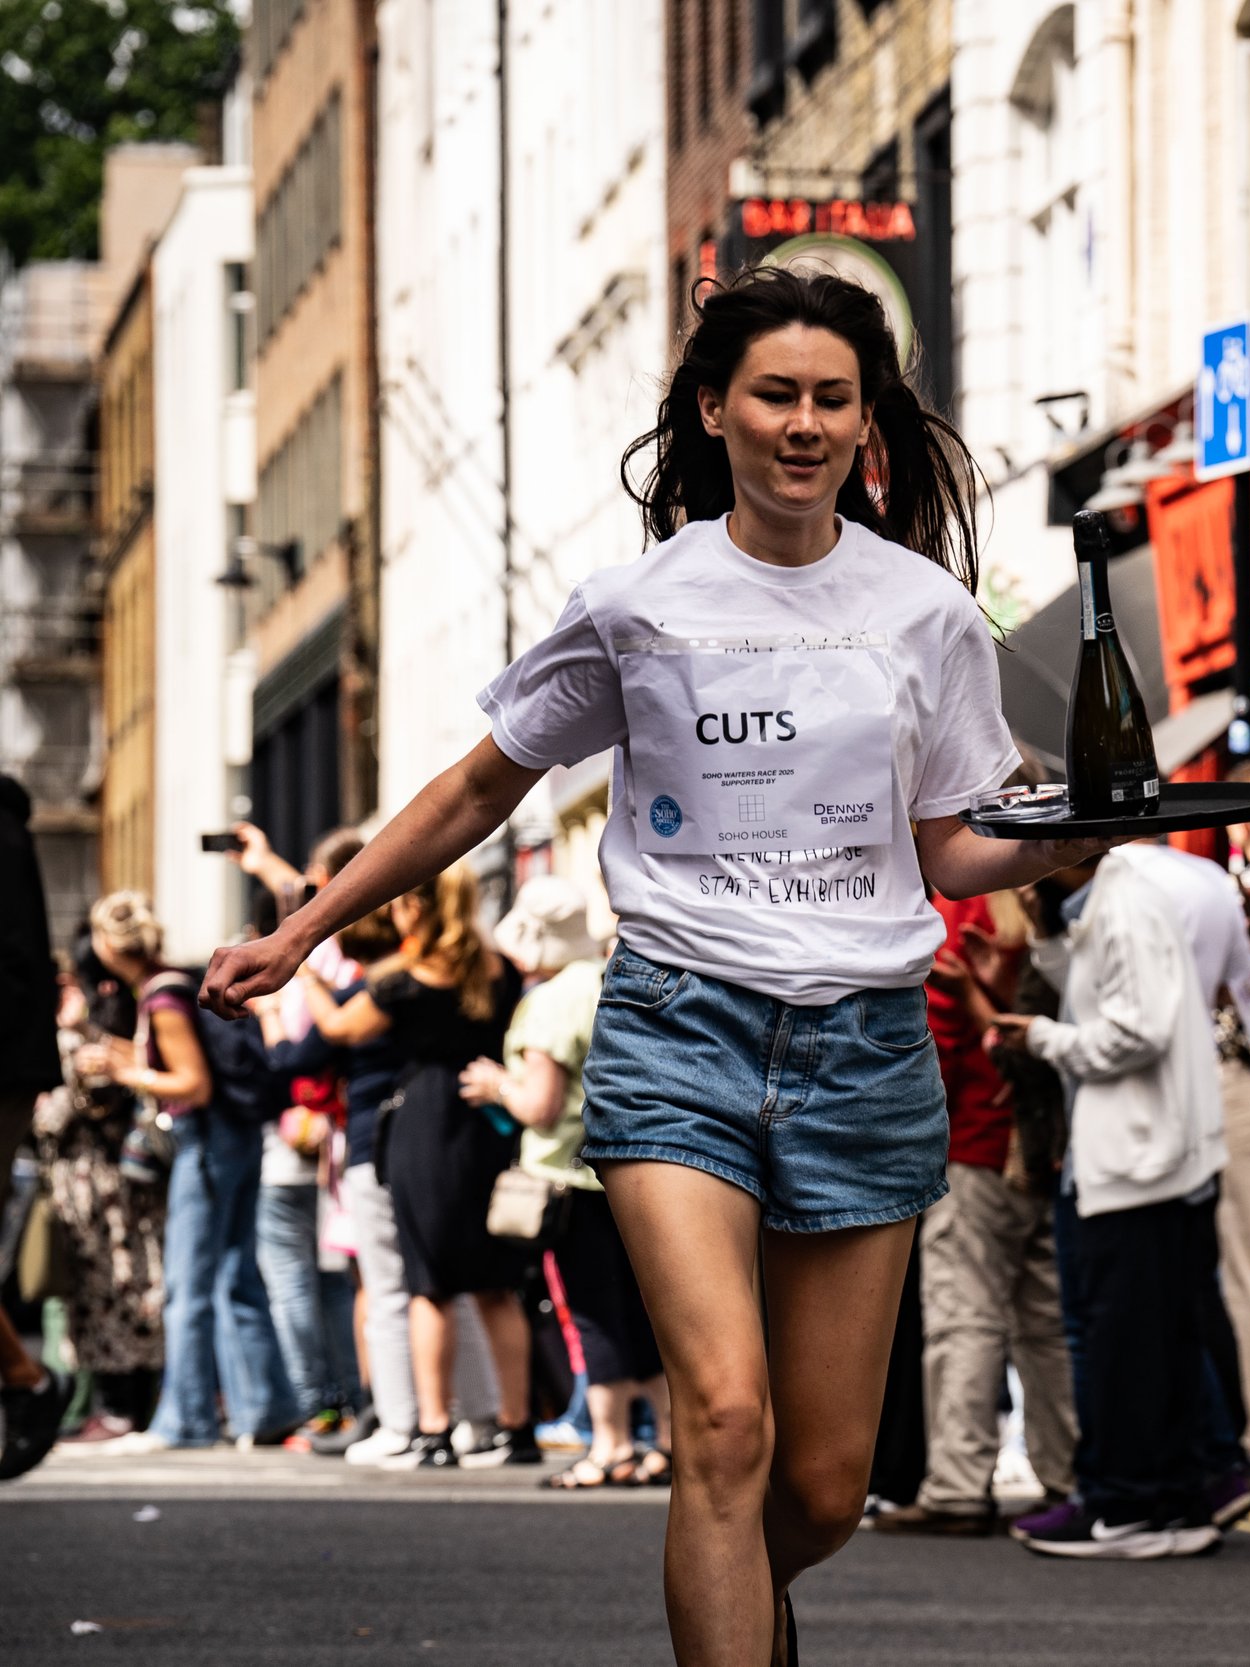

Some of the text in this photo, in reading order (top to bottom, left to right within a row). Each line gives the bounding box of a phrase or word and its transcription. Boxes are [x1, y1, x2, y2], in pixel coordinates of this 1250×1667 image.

[744, 199, 915, 240] BAR ITALIA
[695, 710, 797, 745] CUTS
[721, 778, 764, 787] SUPPORTED
[654, 809, 677, 819] SOHO
[820, 814, 869, 825] BRANDS
[718, 829, 788, 841] SOHO HOUSE
[699, 872, 876, 904] STAFF EXHIBITION
